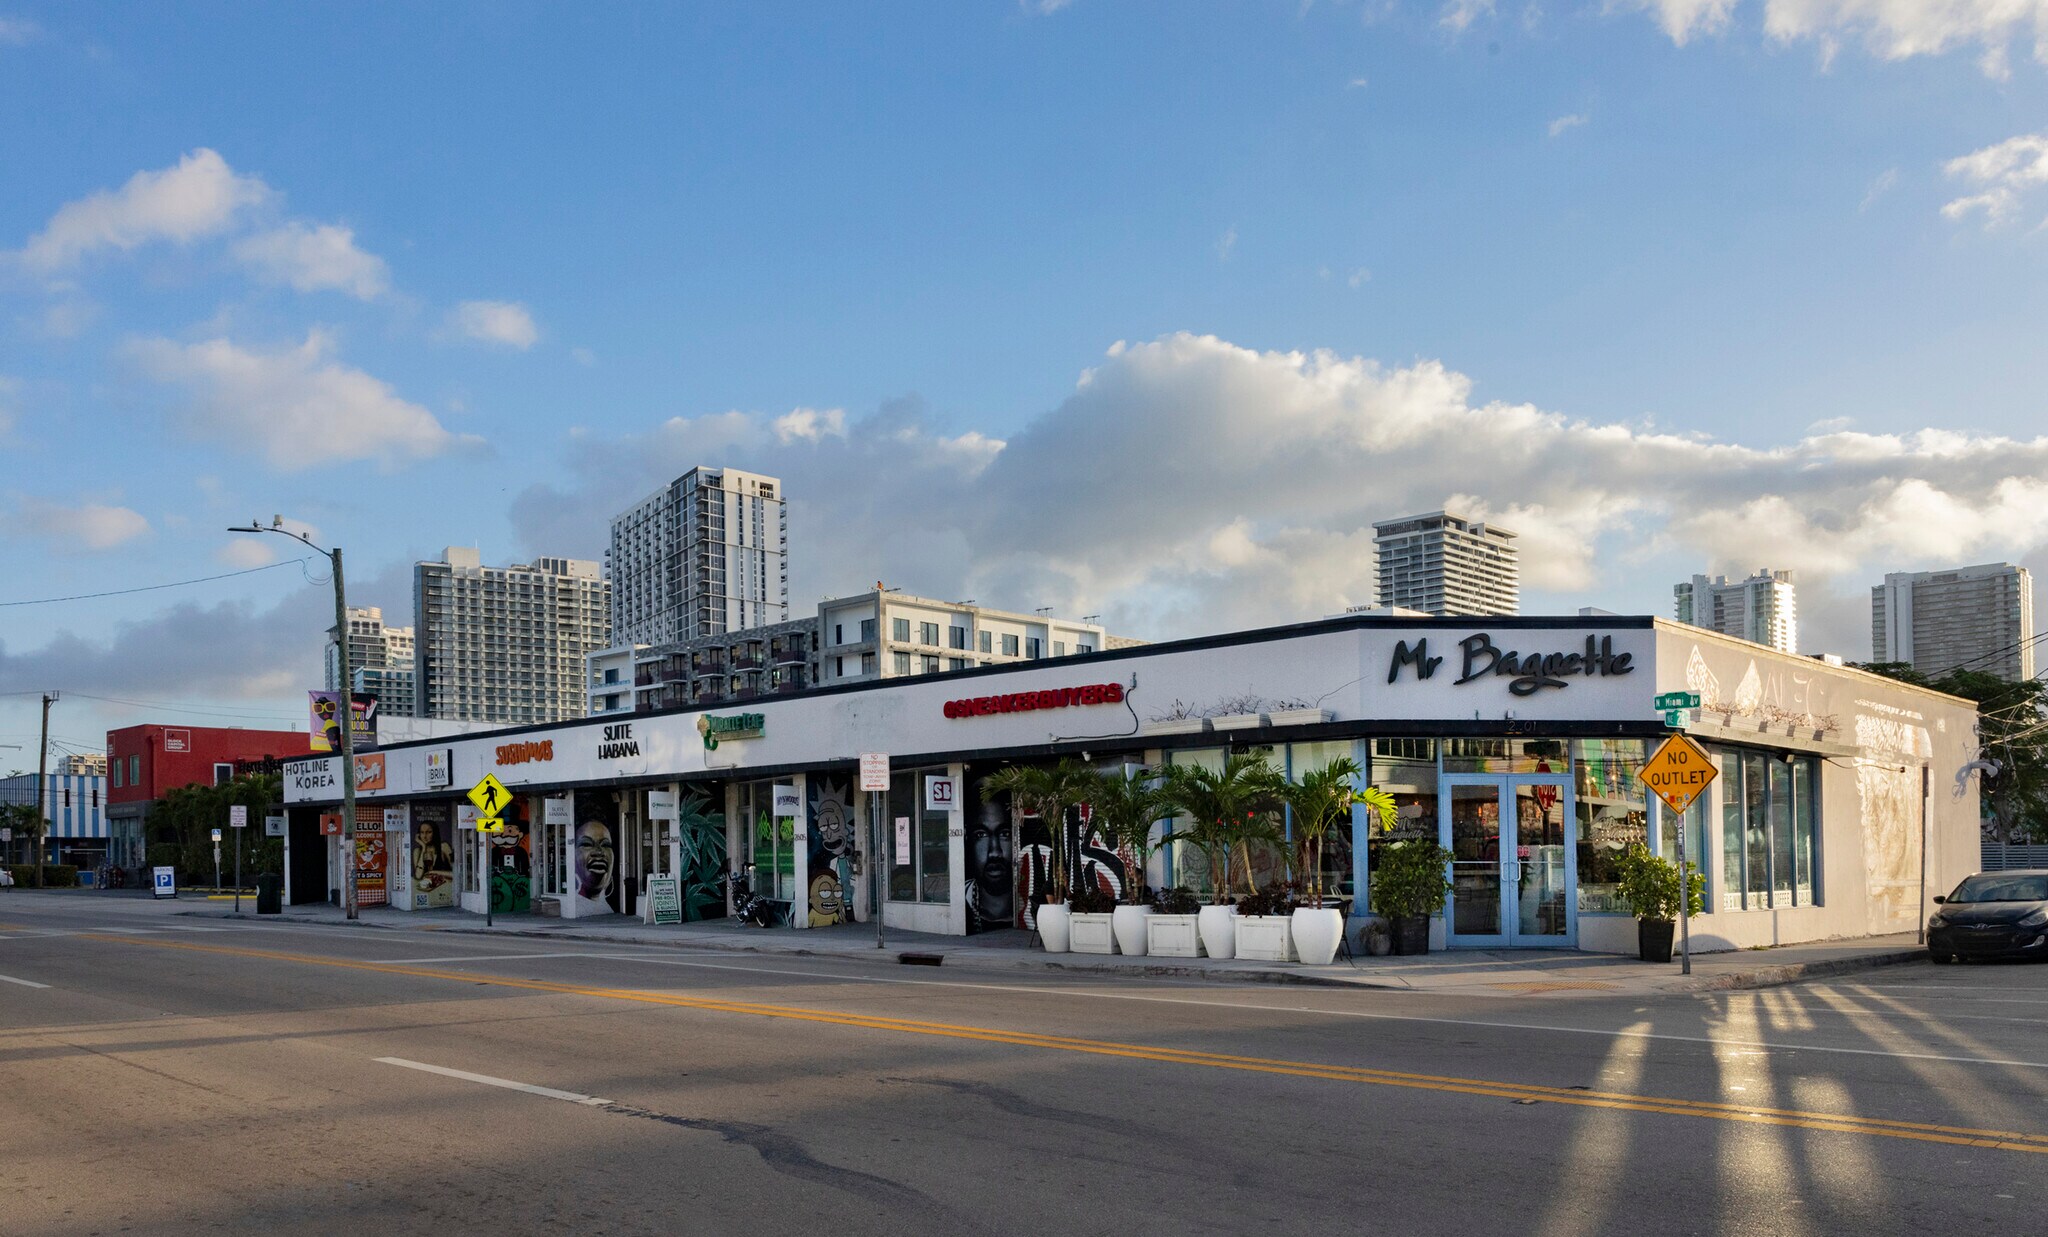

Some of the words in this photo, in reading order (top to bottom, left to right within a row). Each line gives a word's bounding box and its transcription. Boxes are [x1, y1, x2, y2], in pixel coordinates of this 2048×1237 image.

[1388, 637, 1443, 685] Mr
[1453, 633, 1635, 696] Baguette
[944, 683, 1123, 718] @SNEAKERBUYERS
[1656, 698, 1661, 707] N
[1666, 697, 1684, 706] Miami
[604, 723, 632, 741] SUITE
[598, 741, 640, 760] HABANA
[1668, 752, 1687, 764] NO
[286, 760, 329, 776] HOTLINE
[296, 775, 335, 789] KOREA
[1652, 771, 1707, 786] OUTLET
[934, 783, 952, 800] SB
[356, 822, 382, 831] ELLO!
